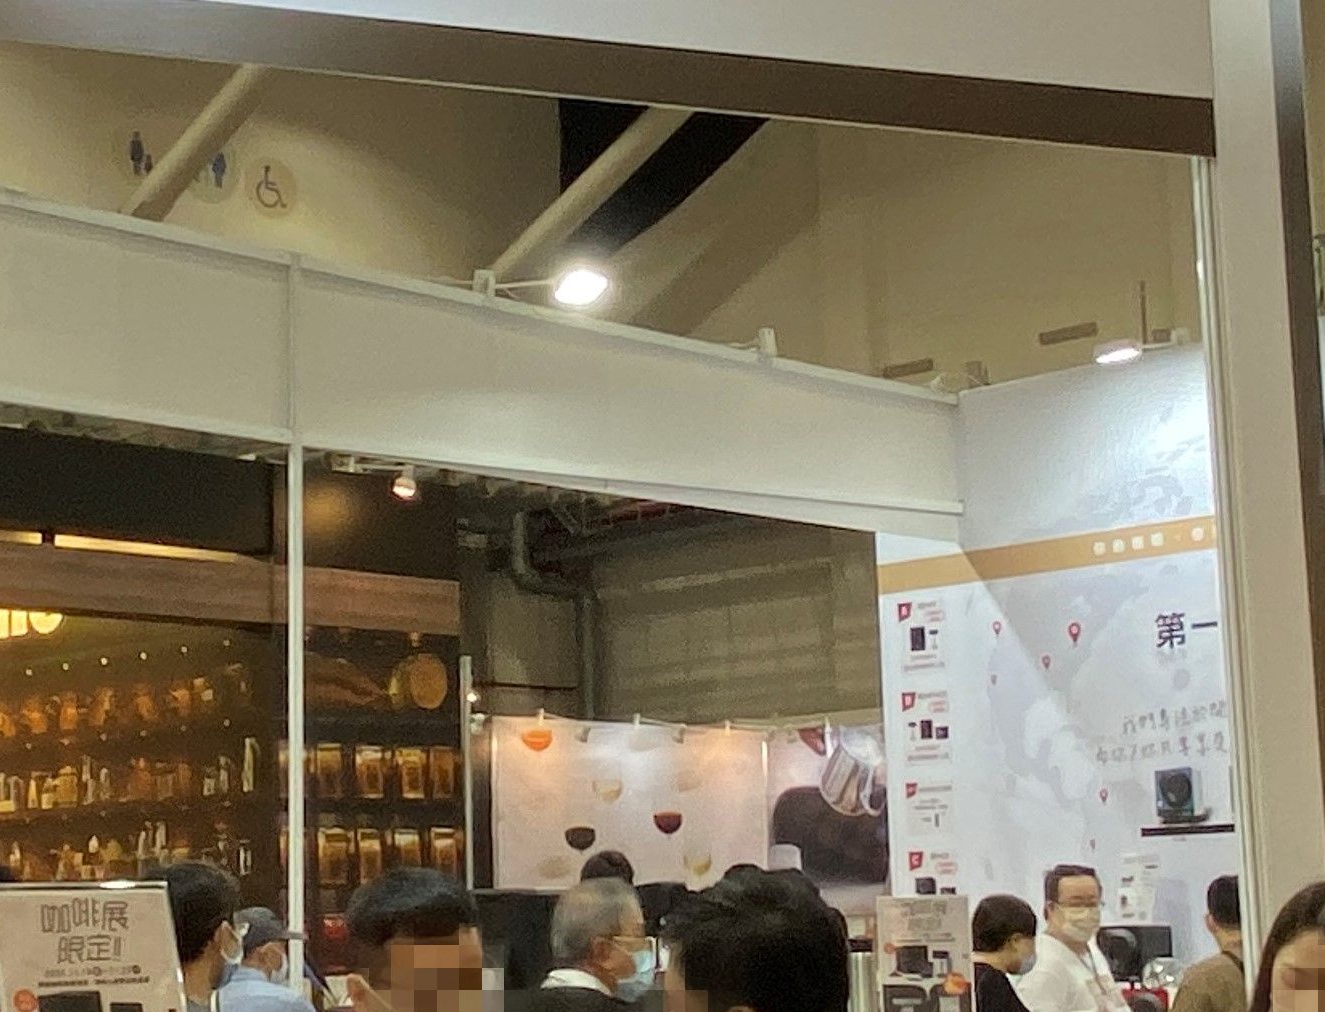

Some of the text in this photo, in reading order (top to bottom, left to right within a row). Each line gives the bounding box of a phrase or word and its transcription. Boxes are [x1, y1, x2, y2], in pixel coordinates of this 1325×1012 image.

[1155, 612, 1218, 649] 第一
[40, 896, 129, 934] 咖啡展
